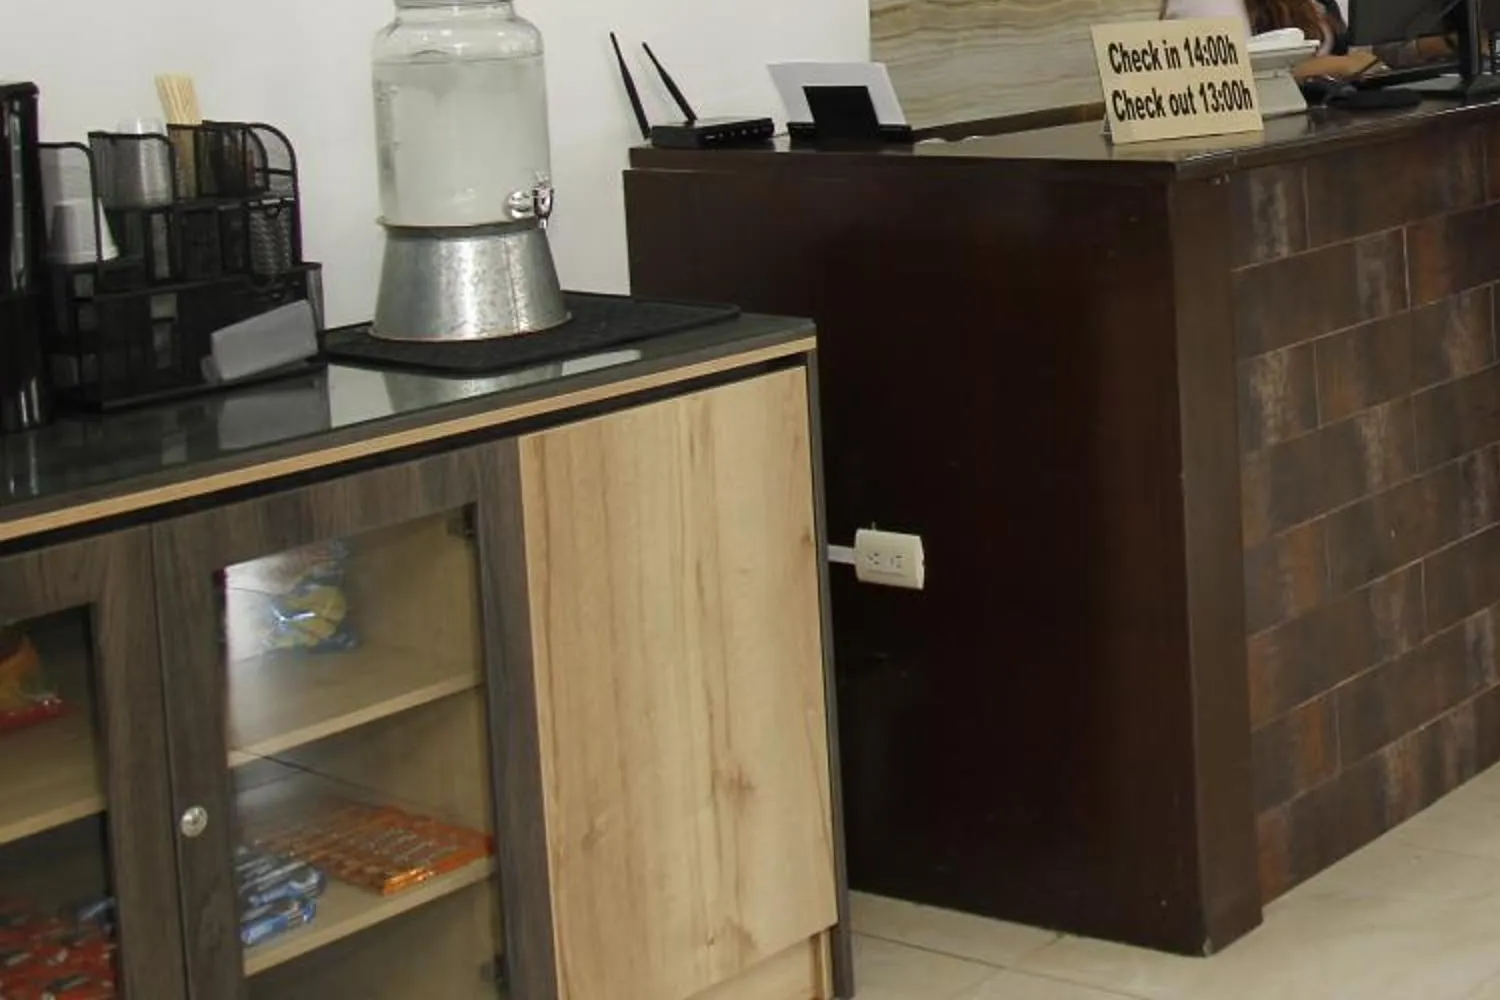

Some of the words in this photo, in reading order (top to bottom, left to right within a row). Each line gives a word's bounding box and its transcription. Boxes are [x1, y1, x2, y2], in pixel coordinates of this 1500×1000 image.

[1108, 40, 1163, 74] Check
[1162, 39, 1181, 69] in
[1183, 34, 1239, 68] 14:00h
[1112, 87, 1166, 121] Check
[1169, 85, 1197, 116] out
[1199, 80, 1253, 113] 13:00h
